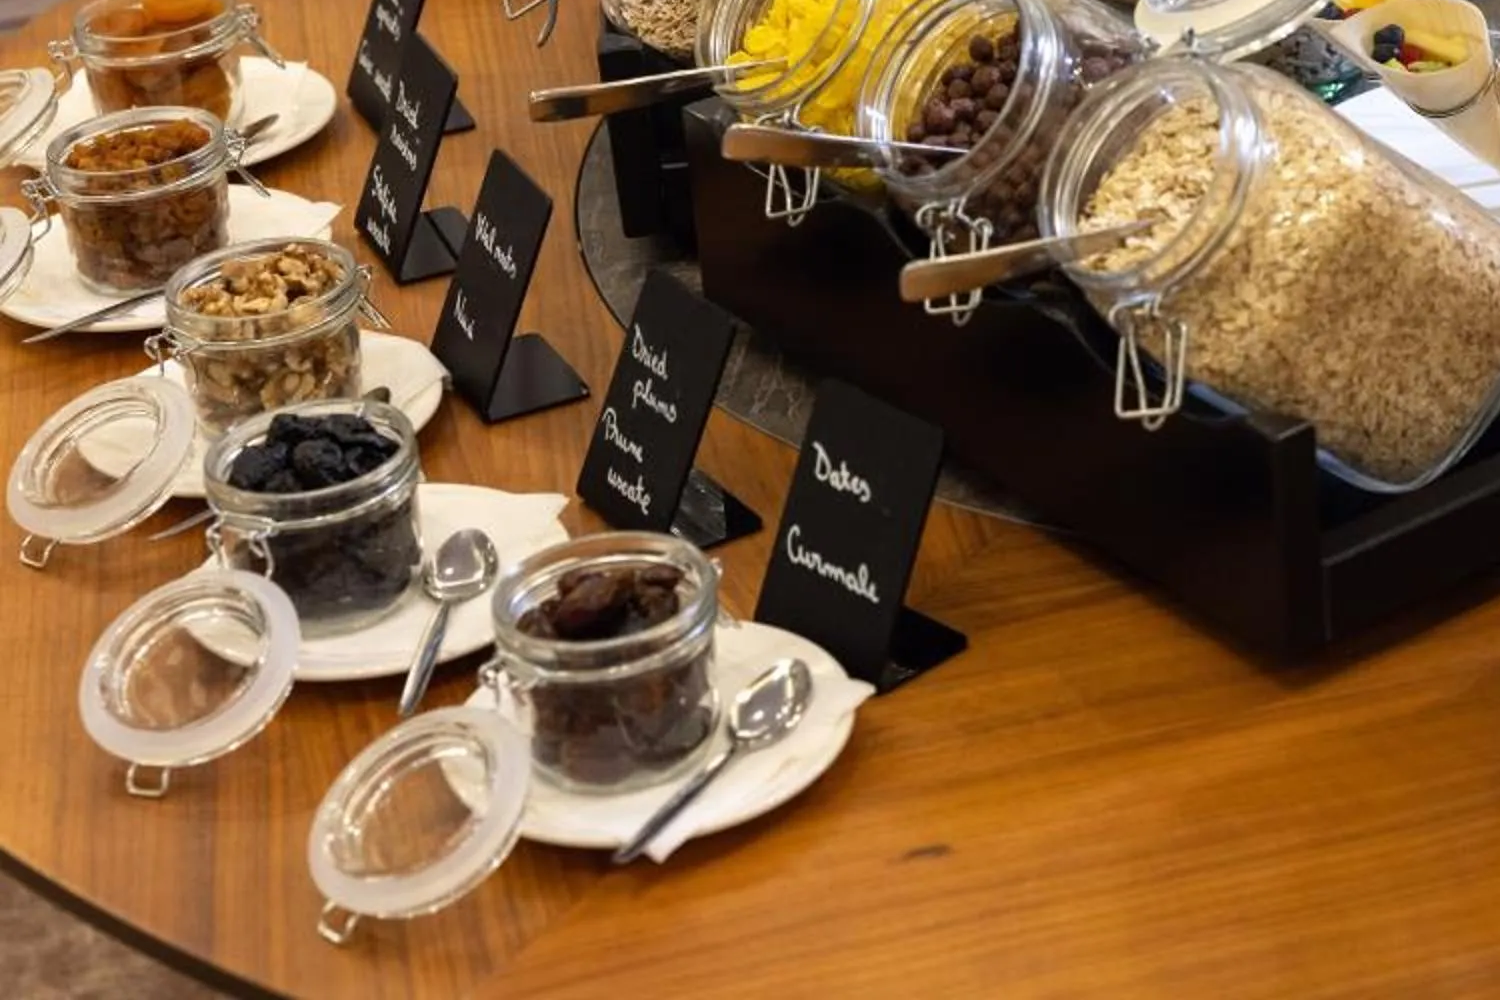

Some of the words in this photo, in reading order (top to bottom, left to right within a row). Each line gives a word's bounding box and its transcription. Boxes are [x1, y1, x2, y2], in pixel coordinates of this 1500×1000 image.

[632, 323, 668, 381] Dried
[632, 379, 677, 424] plums
[602, 407, 643, 463] Prune
[608, 467, 652, 516] uscate
[812, 440, 872, 502] Dates
[787, 524, 880, 603] Curmale
